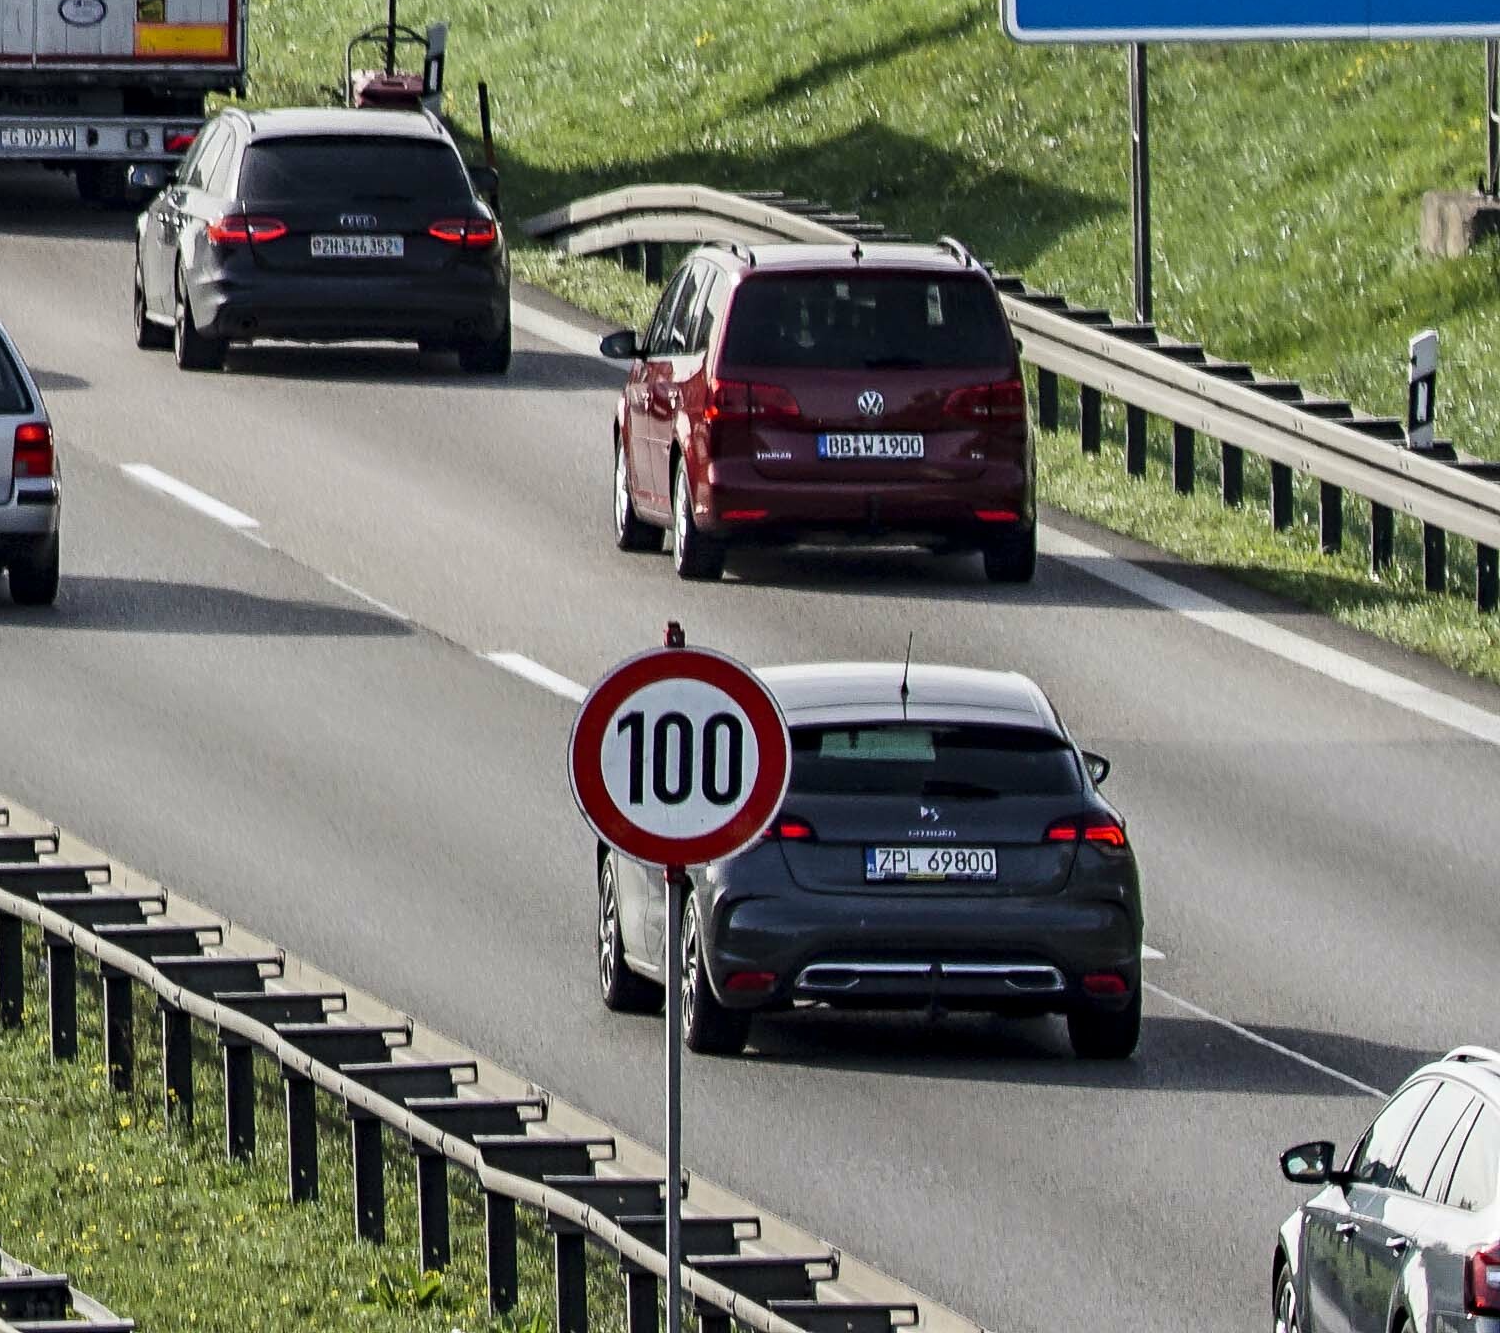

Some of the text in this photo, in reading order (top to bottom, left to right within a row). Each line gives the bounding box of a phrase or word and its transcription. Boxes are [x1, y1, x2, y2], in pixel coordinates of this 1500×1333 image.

[828, 436, 922, 456] BB W 1900
[617, 710, 744, 806] 100
[879, 849, 994, 873] ZPL 69800
